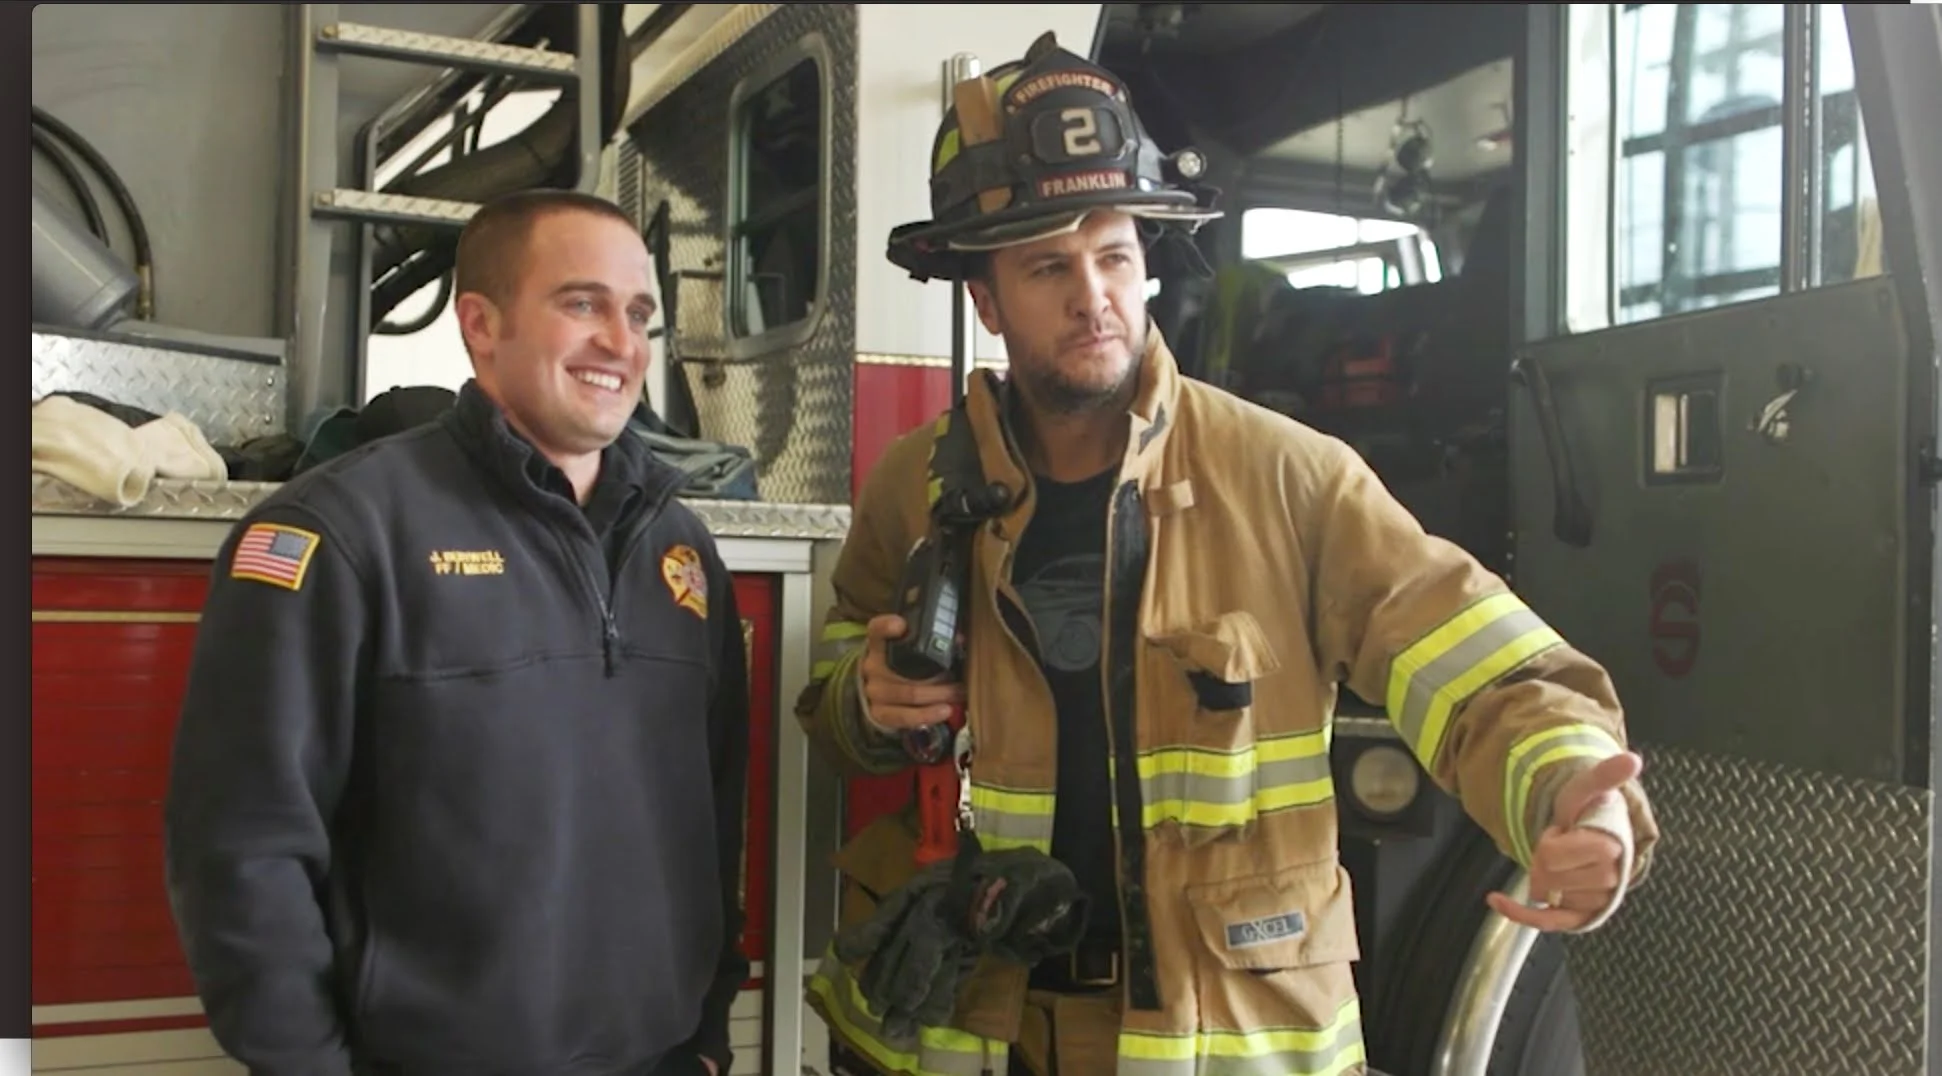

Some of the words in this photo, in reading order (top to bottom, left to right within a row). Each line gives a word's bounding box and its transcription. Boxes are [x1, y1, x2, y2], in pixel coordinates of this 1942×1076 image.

[1013, 73, 1116, 104] FIREFIGHTER
[1061, 108, 1101, 155] 2
[1041, 171, 1127, 197] FRANKLIN
